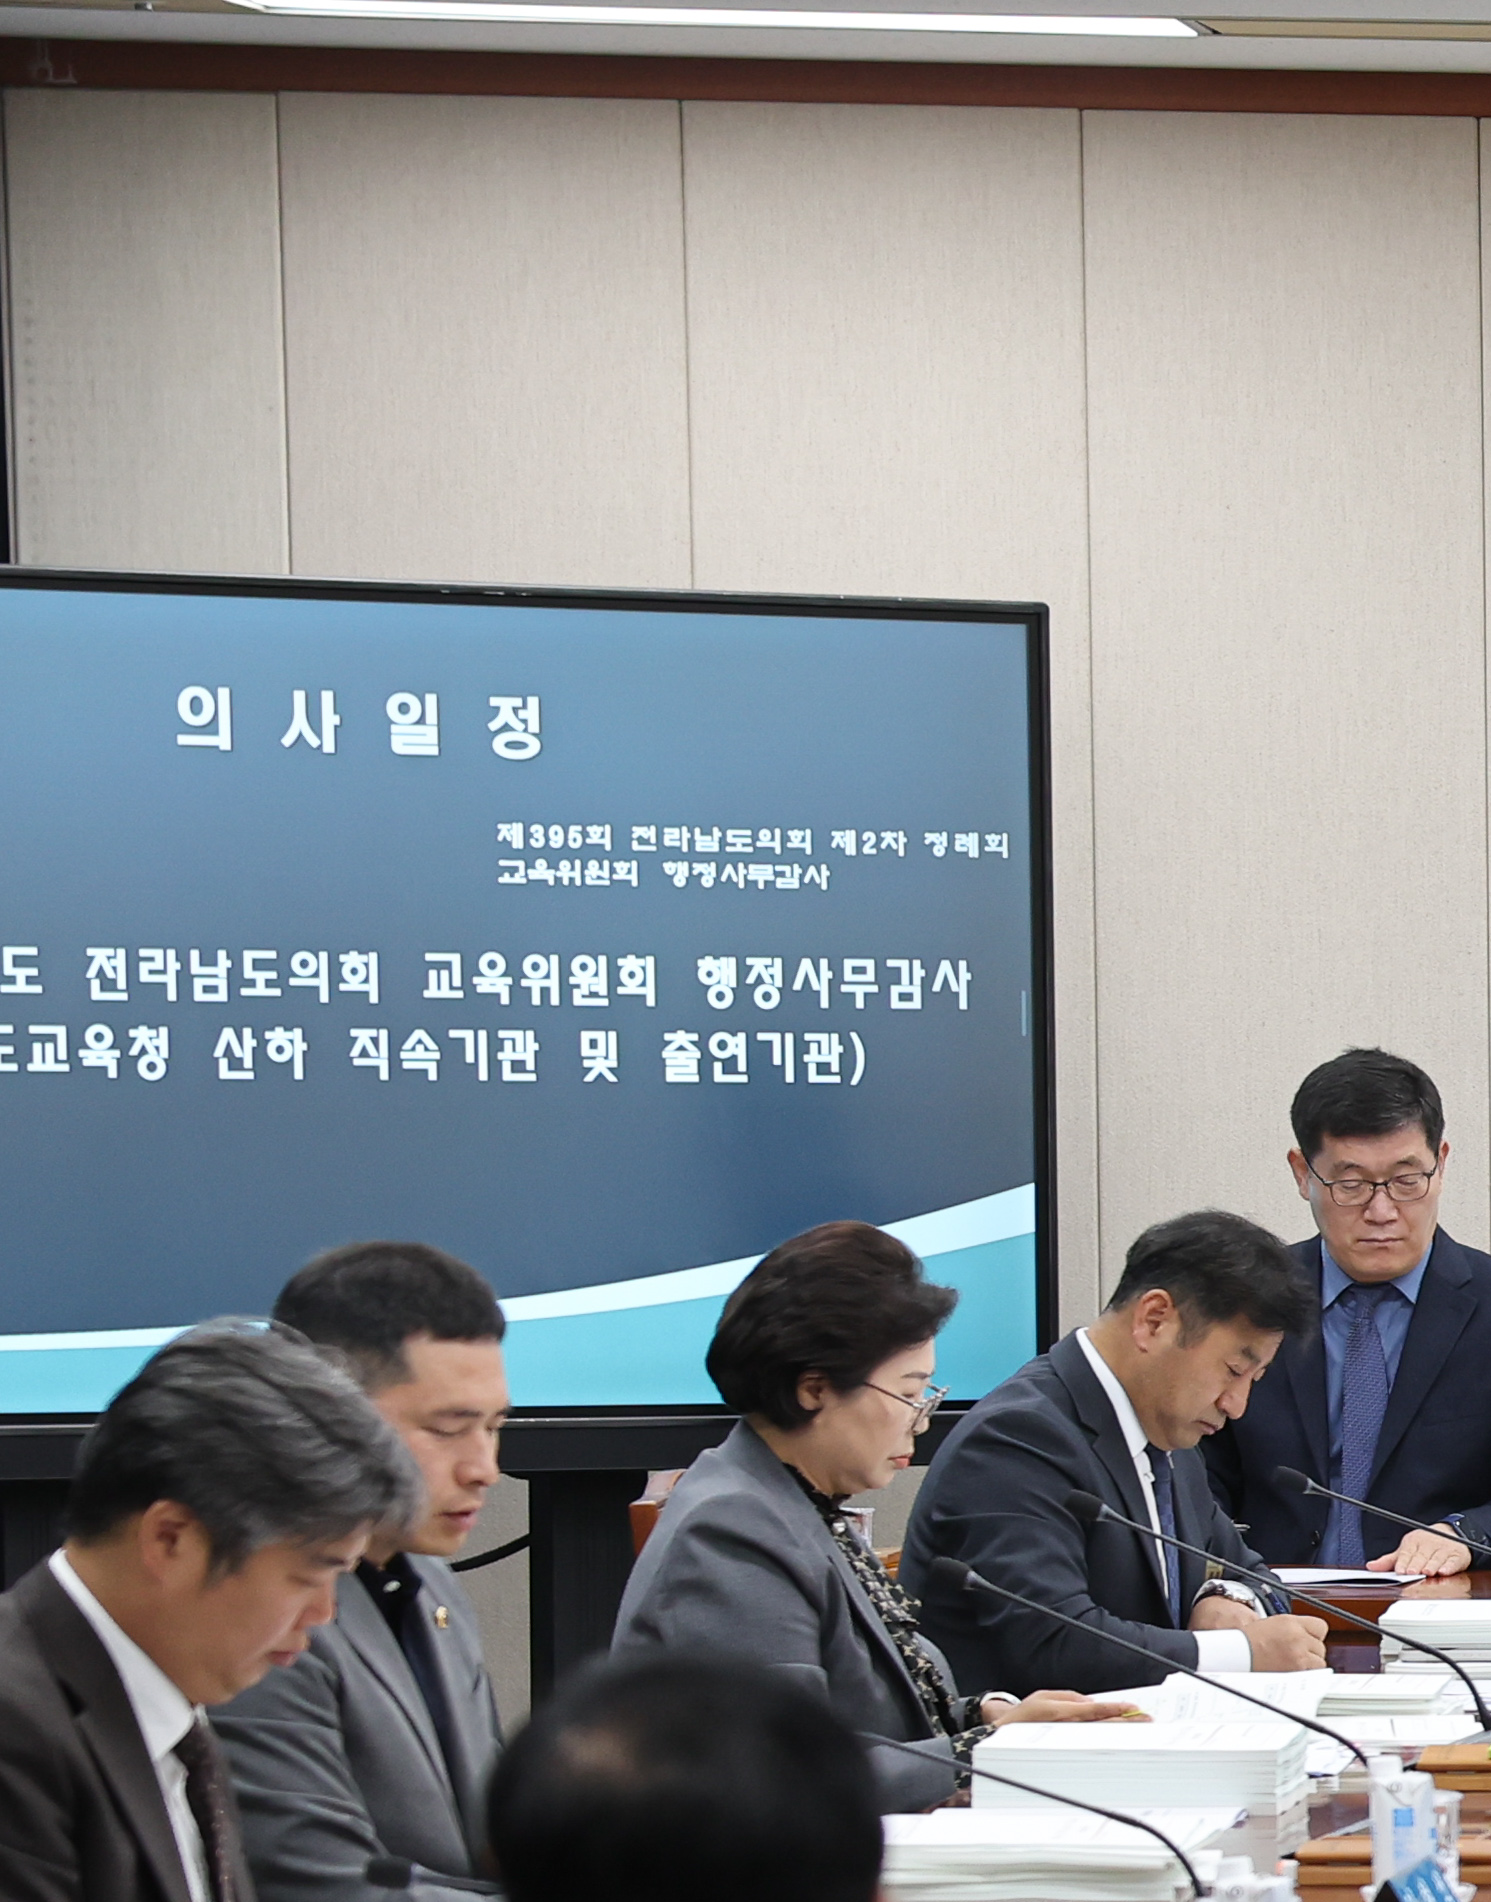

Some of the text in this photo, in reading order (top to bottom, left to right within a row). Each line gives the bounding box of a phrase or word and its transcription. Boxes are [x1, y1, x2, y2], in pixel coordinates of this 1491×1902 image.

[498, 823, 1008, 858] 제395회 전라남도의회 제2차 정례회
[498, 859, 830, 890] 교육위원회 행정사무감사
[0, 947, 971, 1009] 도 전라남도의회 교육위원회 행정사무감사
[214, 1027, 307, 1079] 산하
[350, 1029, 538, 1081] 직속기관
[581, 1031, 617, 1082] 및
[662, 1031, 864, 1085] 출연기관)
